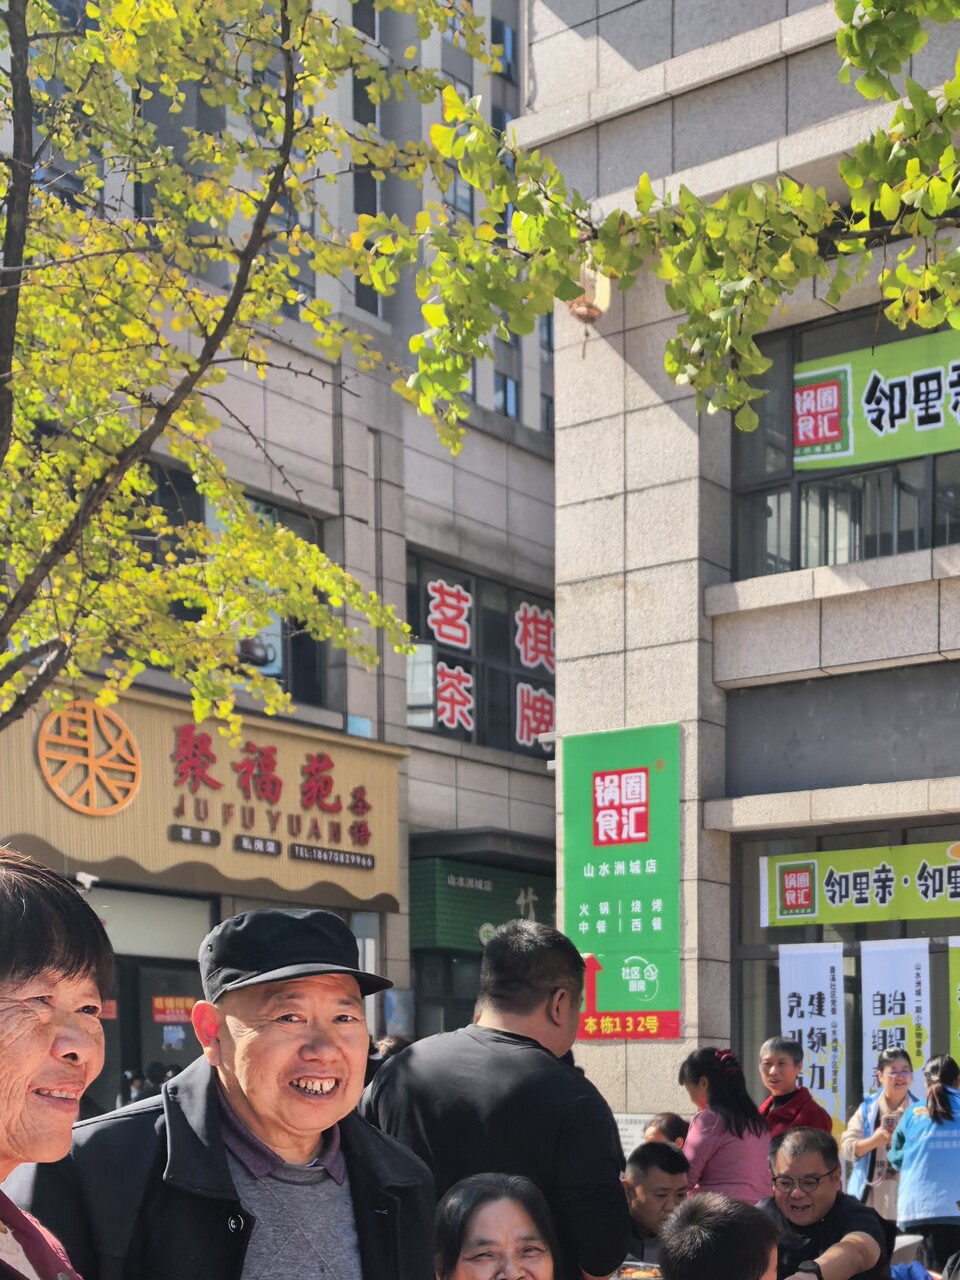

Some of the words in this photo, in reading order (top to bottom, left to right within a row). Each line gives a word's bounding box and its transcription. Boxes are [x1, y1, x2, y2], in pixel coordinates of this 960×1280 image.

[428, 579, 474, 731] 茗茶
[170, 723, 343, 814] 聚福苑
[594, 771, 647, 807] 锅圈
[173, 794, 342, 844] JUFUYUAN
[595, 806, 647, 841] 食汇
[584, 859, 657, 878] 山水洲城店
[578, 901, 610, 917] 火锅
[631, 898, 663, 913] 烧烤
[578, 920, 607, 934] 中餐
[631, 917, 662, 932] 西餐
[621, 966, 641, 980] 社区
[787, 991, 826, 1019] 党建
[872, 989, 906, 1016] 自治
[584, 1016, 660, 1034] 本栋132号
